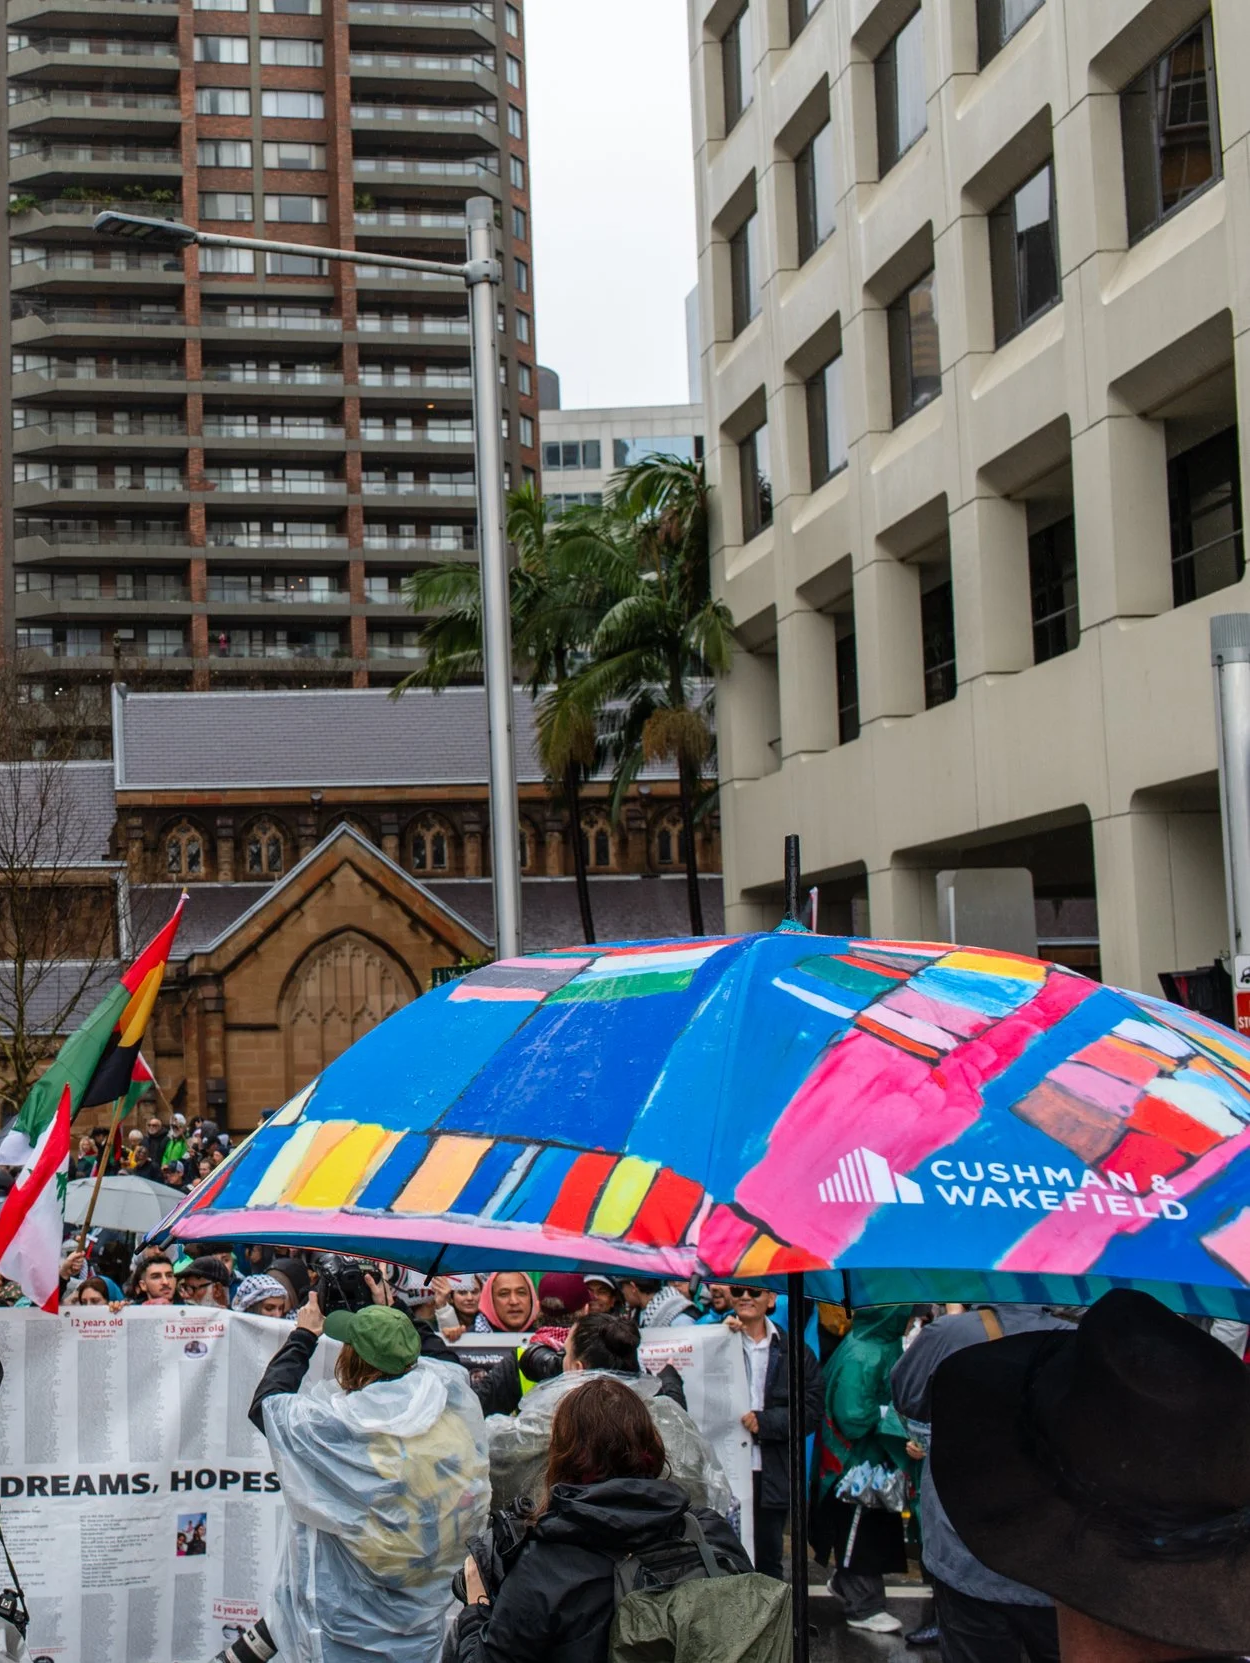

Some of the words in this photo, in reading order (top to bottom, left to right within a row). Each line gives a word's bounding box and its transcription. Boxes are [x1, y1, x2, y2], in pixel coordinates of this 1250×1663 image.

[930, 1160, 1138, 1193] CUSHMAN
[1151, 1174, 1179, 1196] &
[935, 1184, 1189, 1221] WAKEFIELD
[70, 1319, 80, 1327] 12
[83, 1320, 106, 1329] years
[109, 1318, 123, 1326] old
[165, 1324, 176, 1333] 13
[179, 1326, 205, 1335] years
[209, 1324, 224, 1332] old
[678, 1345, 693, 1353] old
[0, 1473, 159, 1498] DREAMS,
[170, 1469, 281, 1493] HOPES
[213, 1603, 222, 1613] 14
[224, 1606, 244, 1615] years
[246, 1607, 258, 1616] old
